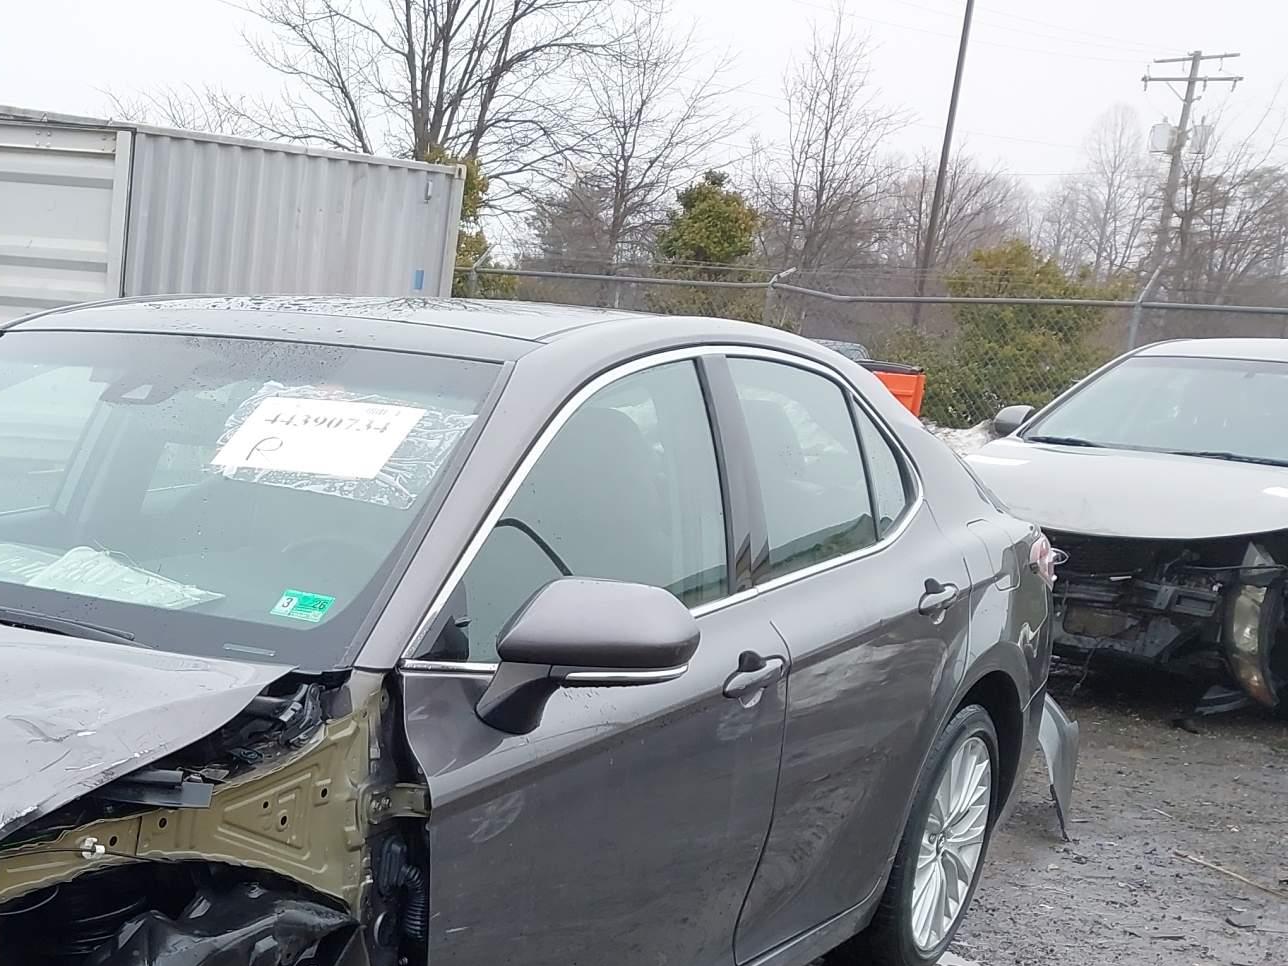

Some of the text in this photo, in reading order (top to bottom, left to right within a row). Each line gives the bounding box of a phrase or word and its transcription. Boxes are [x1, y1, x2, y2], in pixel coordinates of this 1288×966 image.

[264, 412, 392, 434] 44390734
[282, 598, 329, 610] 3 26
